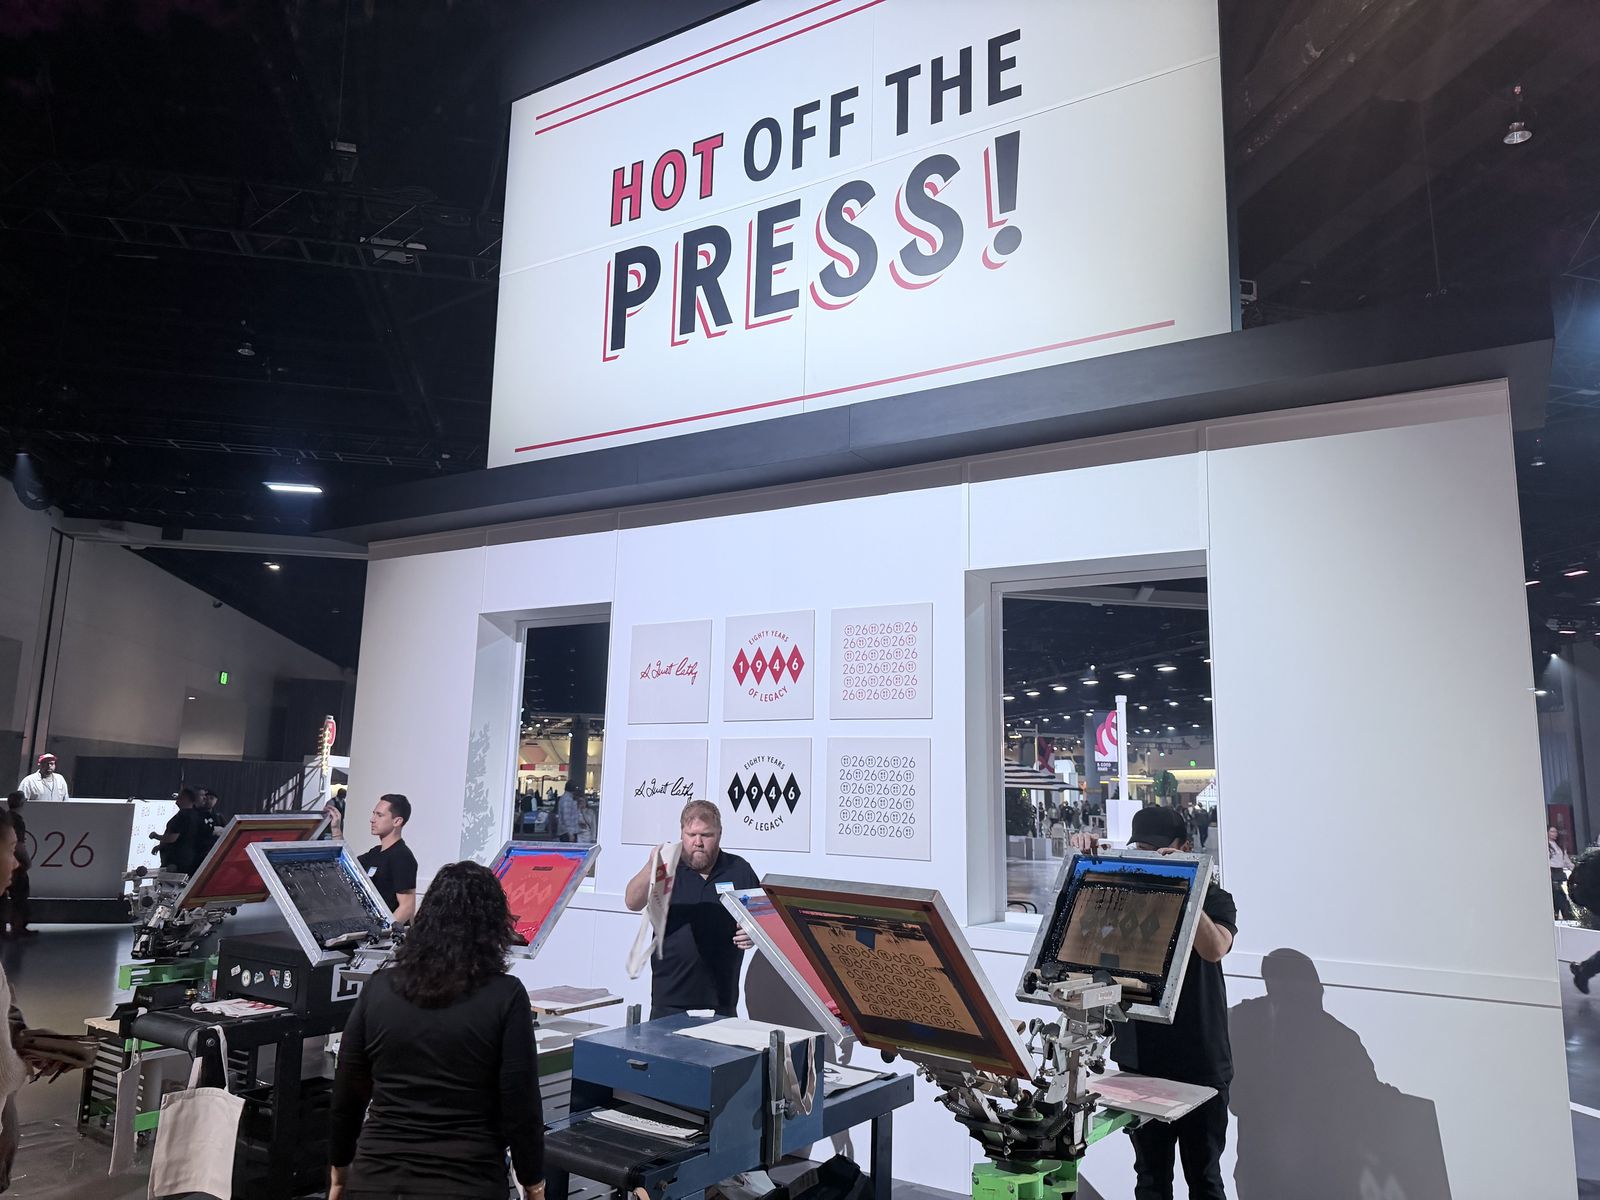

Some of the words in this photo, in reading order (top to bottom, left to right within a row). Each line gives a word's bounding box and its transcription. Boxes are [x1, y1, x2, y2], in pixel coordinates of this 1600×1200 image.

[609, 132, 724, 228] HOT
[743, 86, 859, 183] OFF
[885, 28, 1023, 136] THE
[602, 129, 1023, 363] PRESS!
[771, 631, 789, 642] YEARS
[748, 687, 758, 698] OF
[760, 686, 788, 702] LEGACY
[744, 755, 765, 770] EIGHTY
[767, 755, 785, 770] YEARS
[733, 786, 795, 800] 1946
[743, 815, 754, 826] OF
[755, 815, 784, 831] LEGACY
